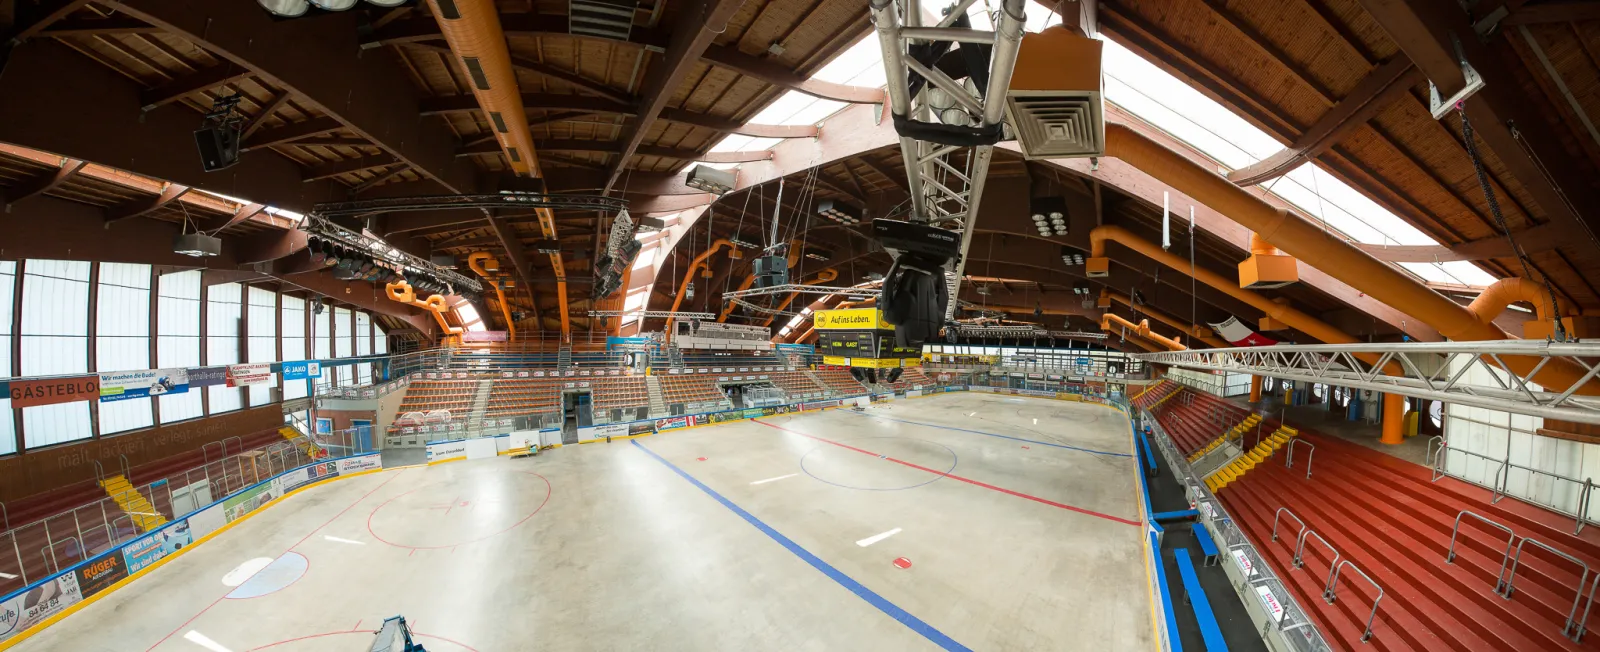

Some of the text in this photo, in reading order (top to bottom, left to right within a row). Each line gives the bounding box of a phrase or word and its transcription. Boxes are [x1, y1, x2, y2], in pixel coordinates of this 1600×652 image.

[830, 316, 841, 324] Auf
[124, 541, 143, 555] SPORT
[143, 537, 154, 546] VOR
[83, 556, 118, 580] RÜGER
[130, 562, 141, 572] Wir
[141, 556, 152, 568] sind
[29, 609, 38, 618] 84
[39, 603, 48, 612] 64
[50, 599, 59, 608] 84
